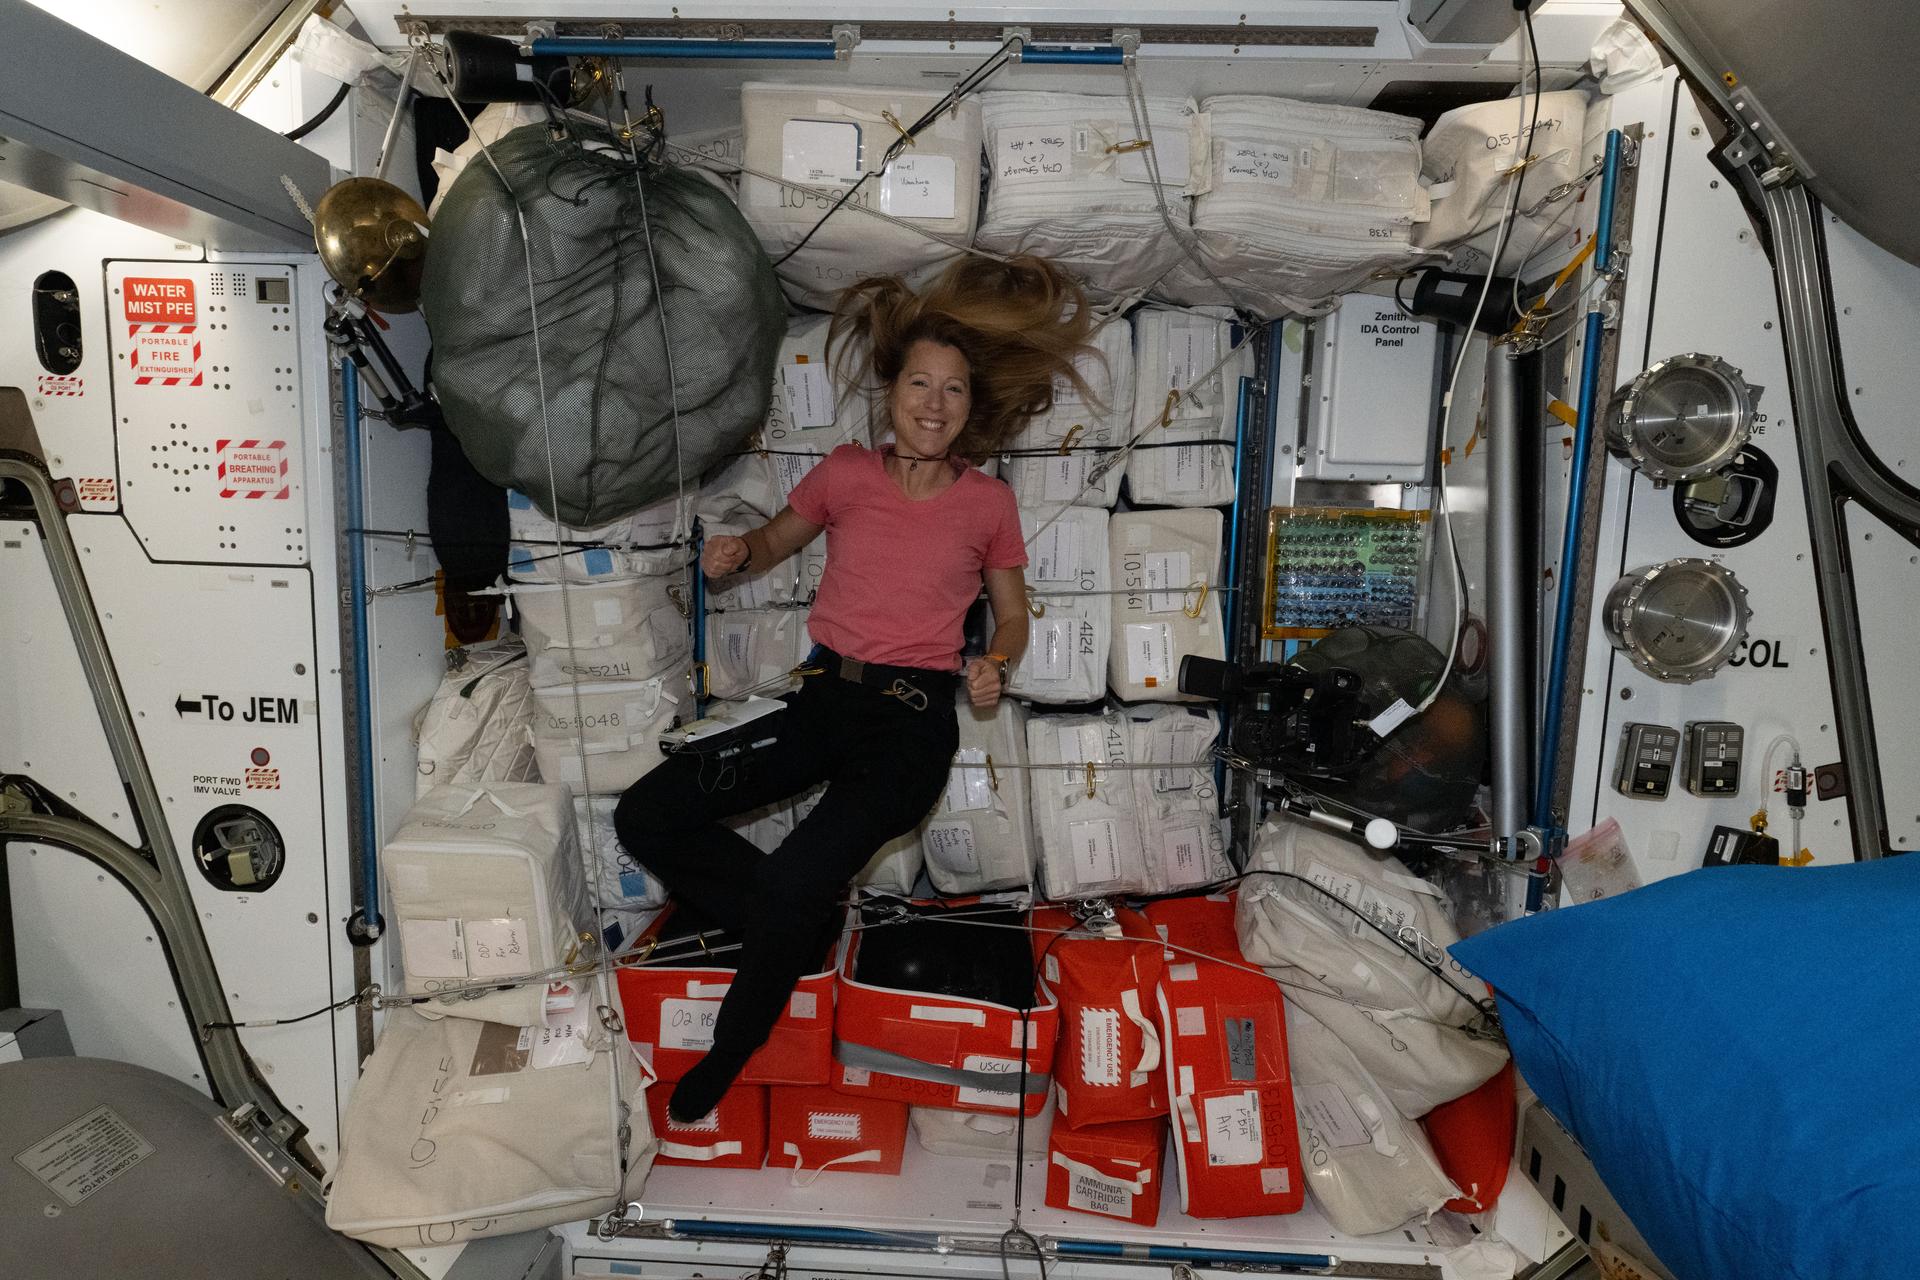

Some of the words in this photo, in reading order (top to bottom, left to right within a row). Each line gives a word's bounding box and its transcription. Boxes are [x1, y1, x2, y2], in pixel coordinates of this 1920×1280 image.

[922, 186, 929, 197] 3
[133, 283, 187, 298] WATER
[128, 301, 162, 315] MIST
[166, 302, 194, 316] PFE
[1375, 311, 1407, 321] Zenith
[1361, 325, 1378, 334] IDA
[1381, 324, 1420, 334] Control
[141, 337, 189, 346] PORTABLE
[1375, 337, 1403, 347] Panel
[151, 351, 180, 361] FIRE
[139, 366, 194, 374] EXTINGUISHER
[233, 453, 272, 461] PORTABLE
[229, 465, 276, 474] BREATHING
[232, 477, 275, 485] APPARATUS
[1728, 639, 1789, 668] COL
[202, 694, 234, 721] To
[243, 697, 299, 724] JEM
[193, 775, 218, 784] PORT
[220, 776, 241, 786] FWD
[193, 786, 210, 794] IMV
[211, 786, 241, 796] VALVE
[700, 1012, 715, 1027] PB
[1105, 1018, 1113, 1062] EMERGENCY
[980, 1062, 1010, 1072] USCV
[1216, 1115, 1232, 1142] Air
[106, 1153, 139, 1177] CLOSING
[79, 1175, 108, 1195] HATCH
[1079, 1175, 1123, 1195] AMMONIA
[1075, 1184, 1126, 1206] CARTRIDGE
[1090, 1201, 1109, 1213] BAG
